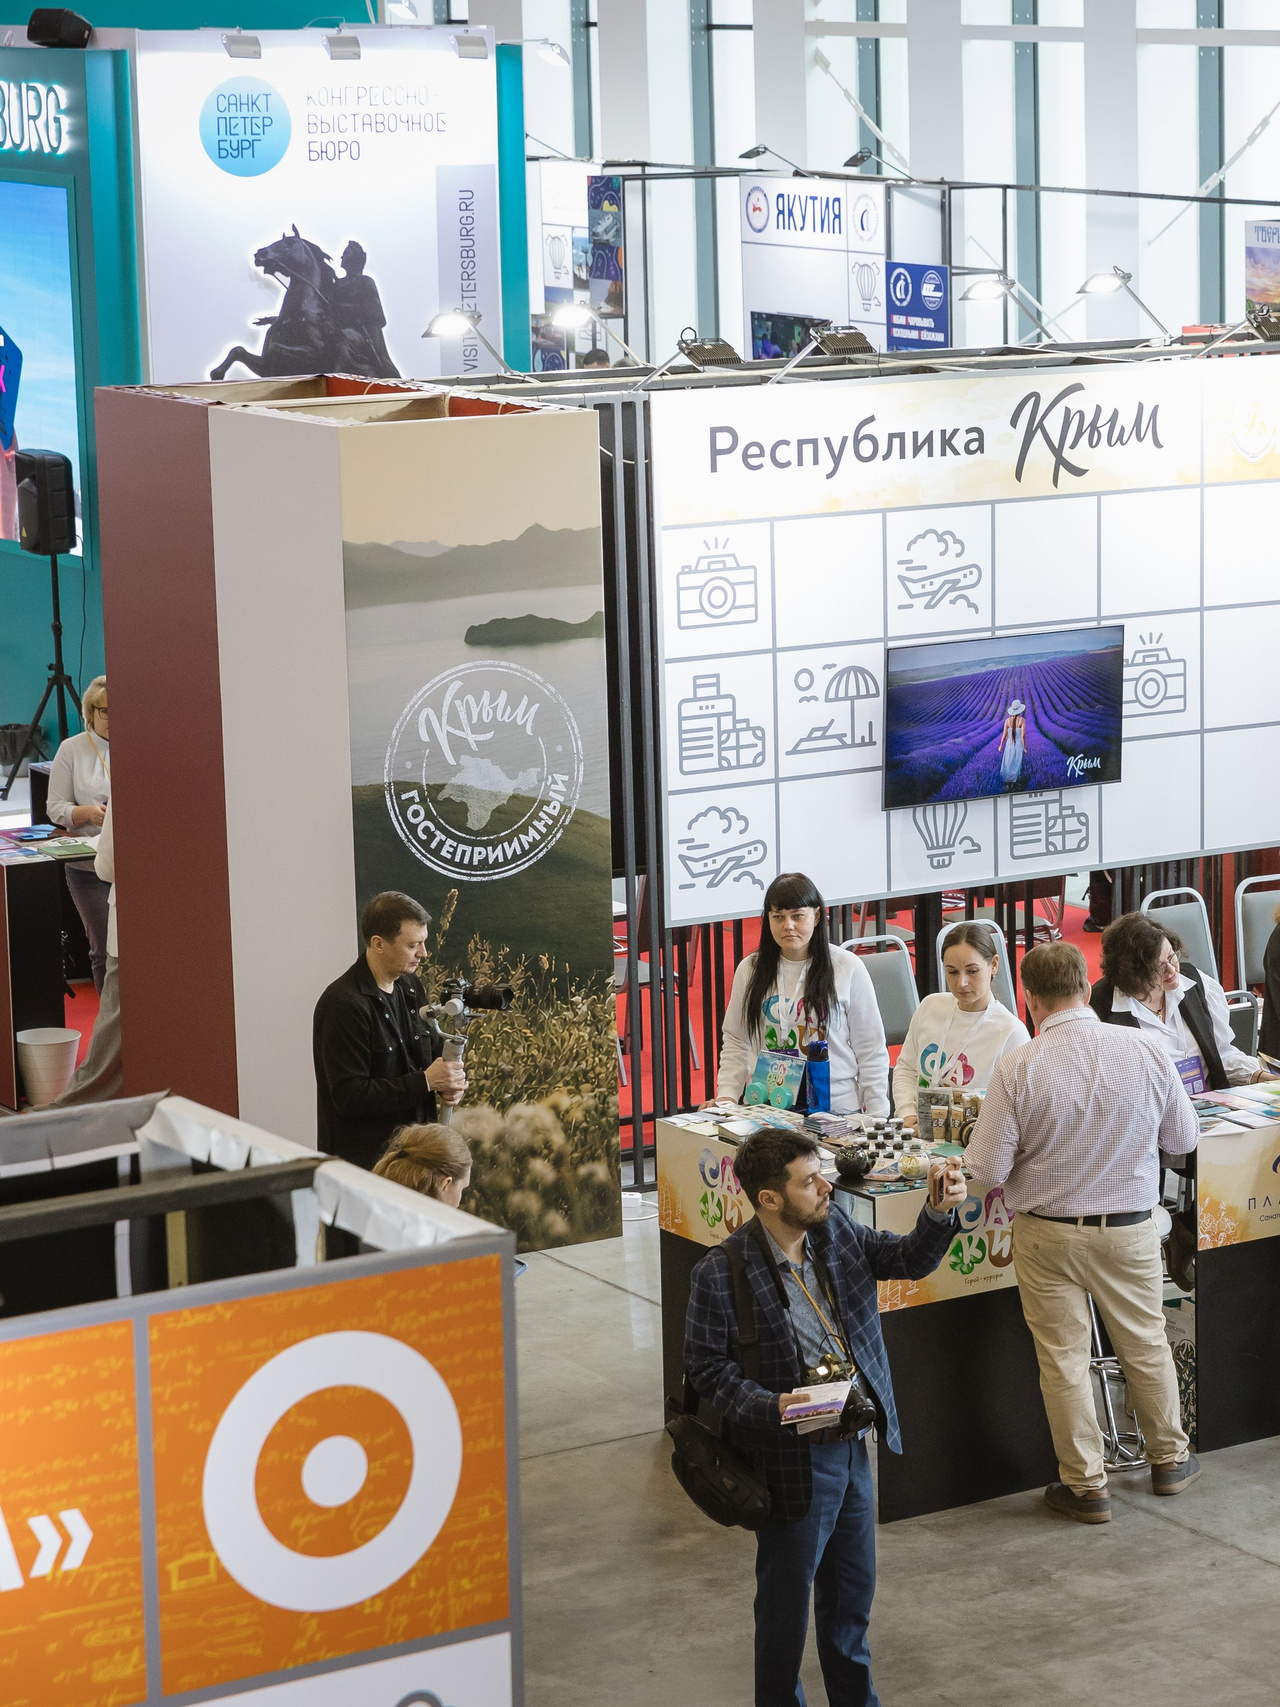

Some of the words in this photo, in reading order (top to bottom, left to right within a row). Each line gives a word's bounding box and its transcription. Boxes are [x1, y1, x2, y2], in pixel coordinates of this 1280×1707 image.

[216, 93, 272, 114] САНКТ
[306, 86, 439, 107] КОНГРЕССНО-
[217, 116, 274, 136] ПЕТЕР
[307, 112, 447, 134] ВЫСТАВОЧНОЕ
[217, 139, 263, 159] БУРГ
[308, 140, 361, 162] БЮРО
[776, 193, 842, 235] ЯКУТИЯ
[458, 189, 479, 373] VISITETERSBURG.RU
[708, 414, 986, 481] Республика
[1010, 382, 1165, 489] Крым
[418, 680, 540, 766] Крым
[1066, 754, 1102, 778] Крым
[400, 772, 570, 866] ГОСТЕПРИИМНЫЙ
